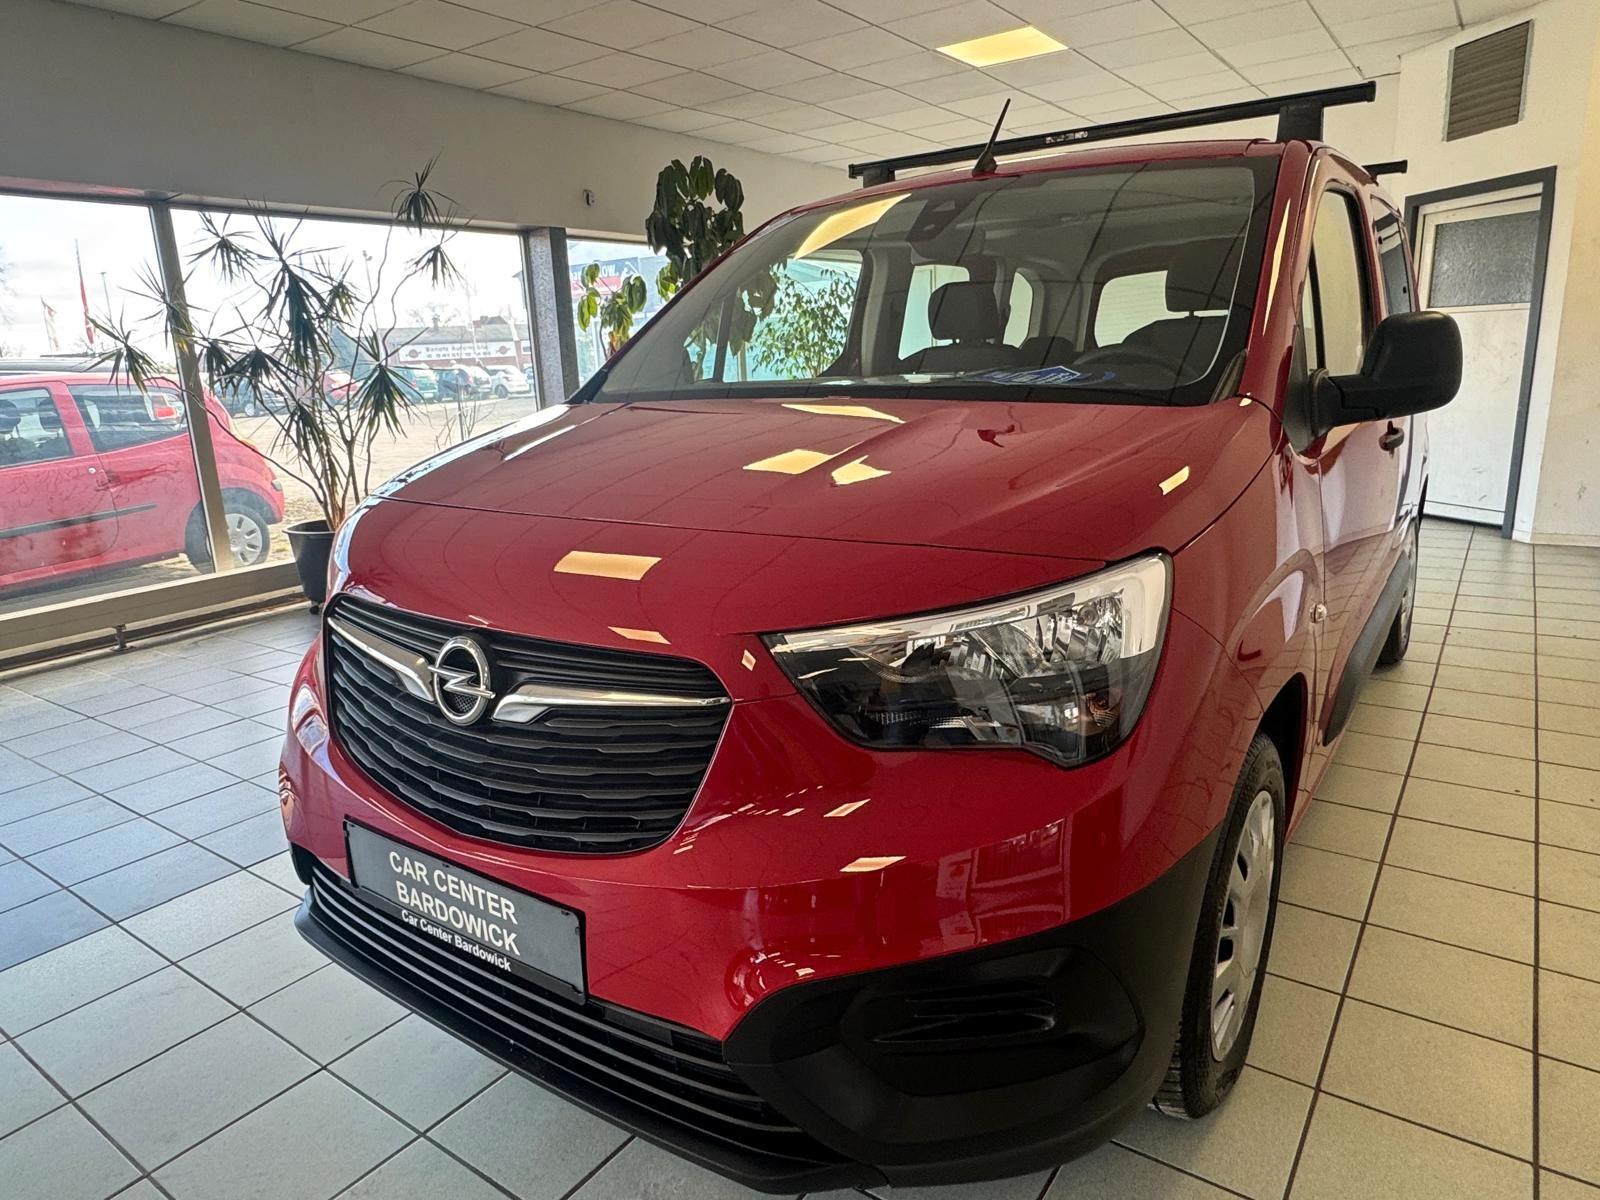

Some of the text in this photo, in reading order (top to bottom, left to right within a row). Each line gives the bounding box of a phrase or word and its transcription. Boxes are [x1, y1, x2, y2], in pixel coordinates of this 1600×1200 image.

[389, 851, 518, 924] CAR CENTER
[396, 880, 520, 955] BARDOWICK
[402, 909, 512, 972] Car Center Bardowick
